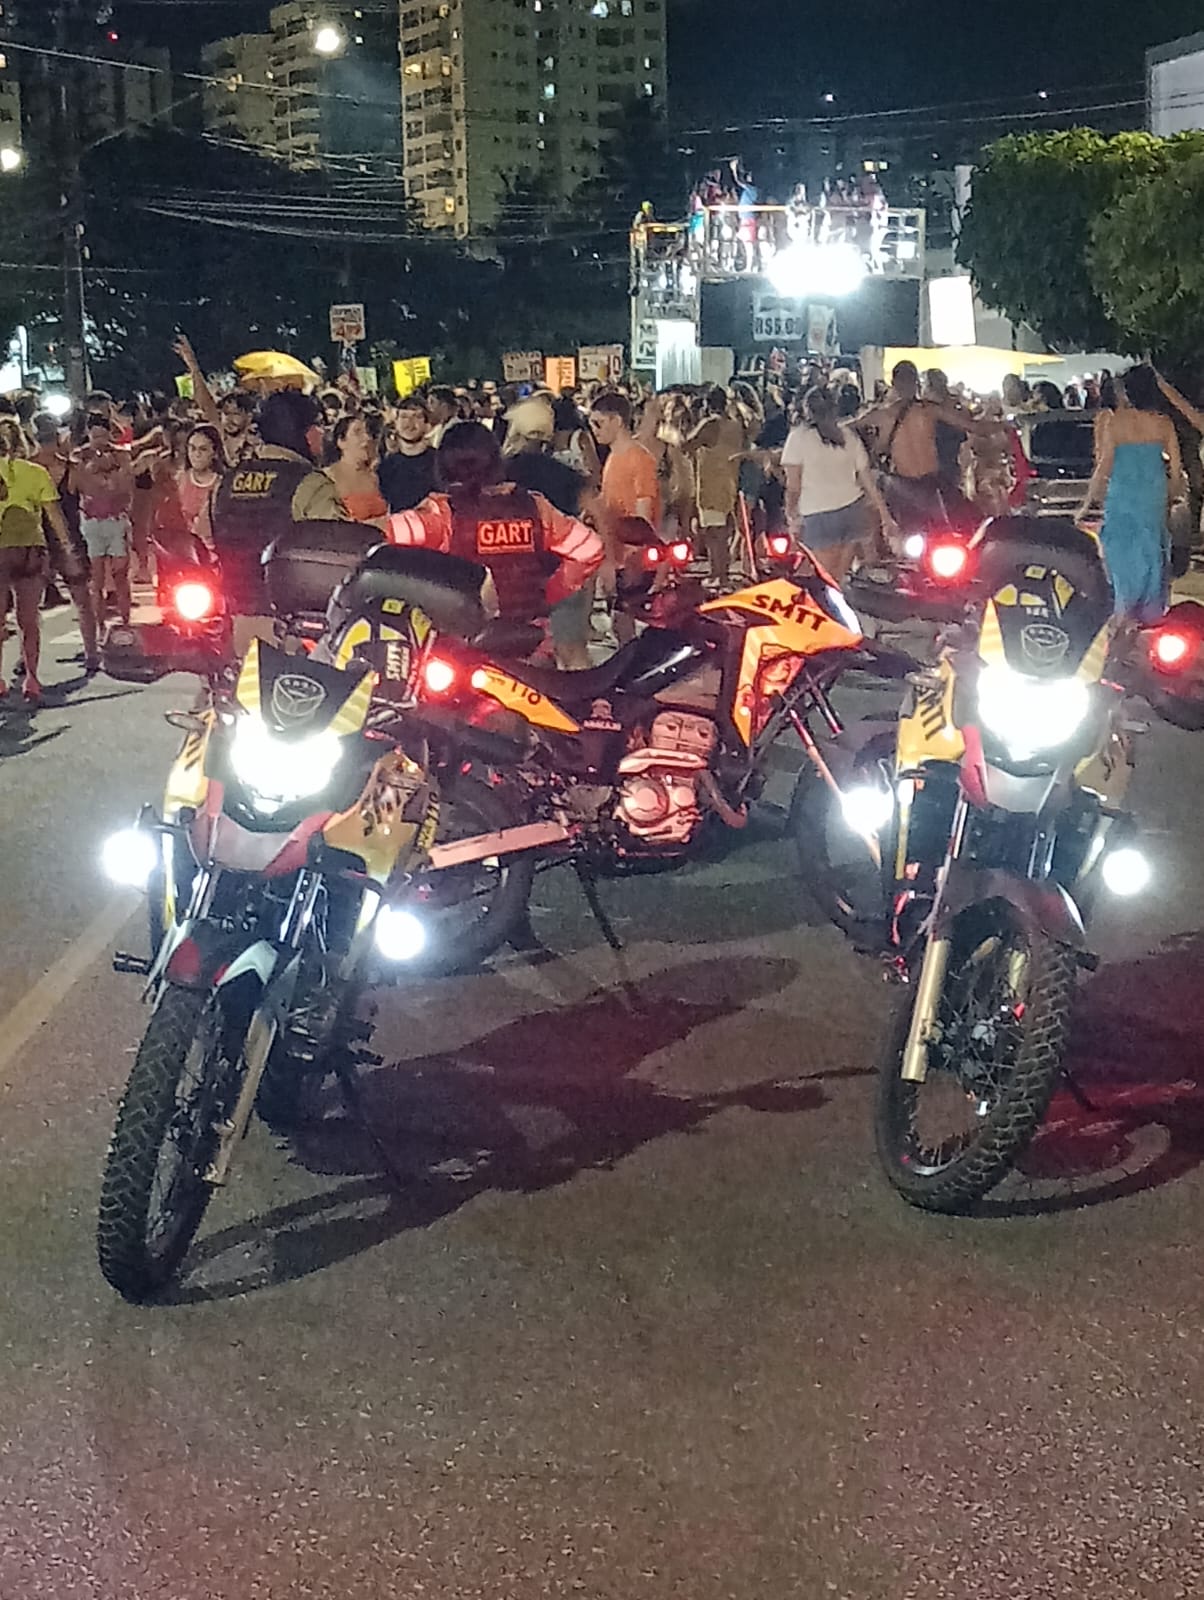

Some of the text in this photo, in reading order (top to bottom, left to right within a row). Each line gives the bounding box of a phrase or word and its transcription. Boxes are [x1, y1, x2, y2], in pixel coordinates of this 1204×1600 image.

[233, 472, 277, 491] GART
[480, 522, 532, 545] GART
[752, 594, 828, 631] SMTT
